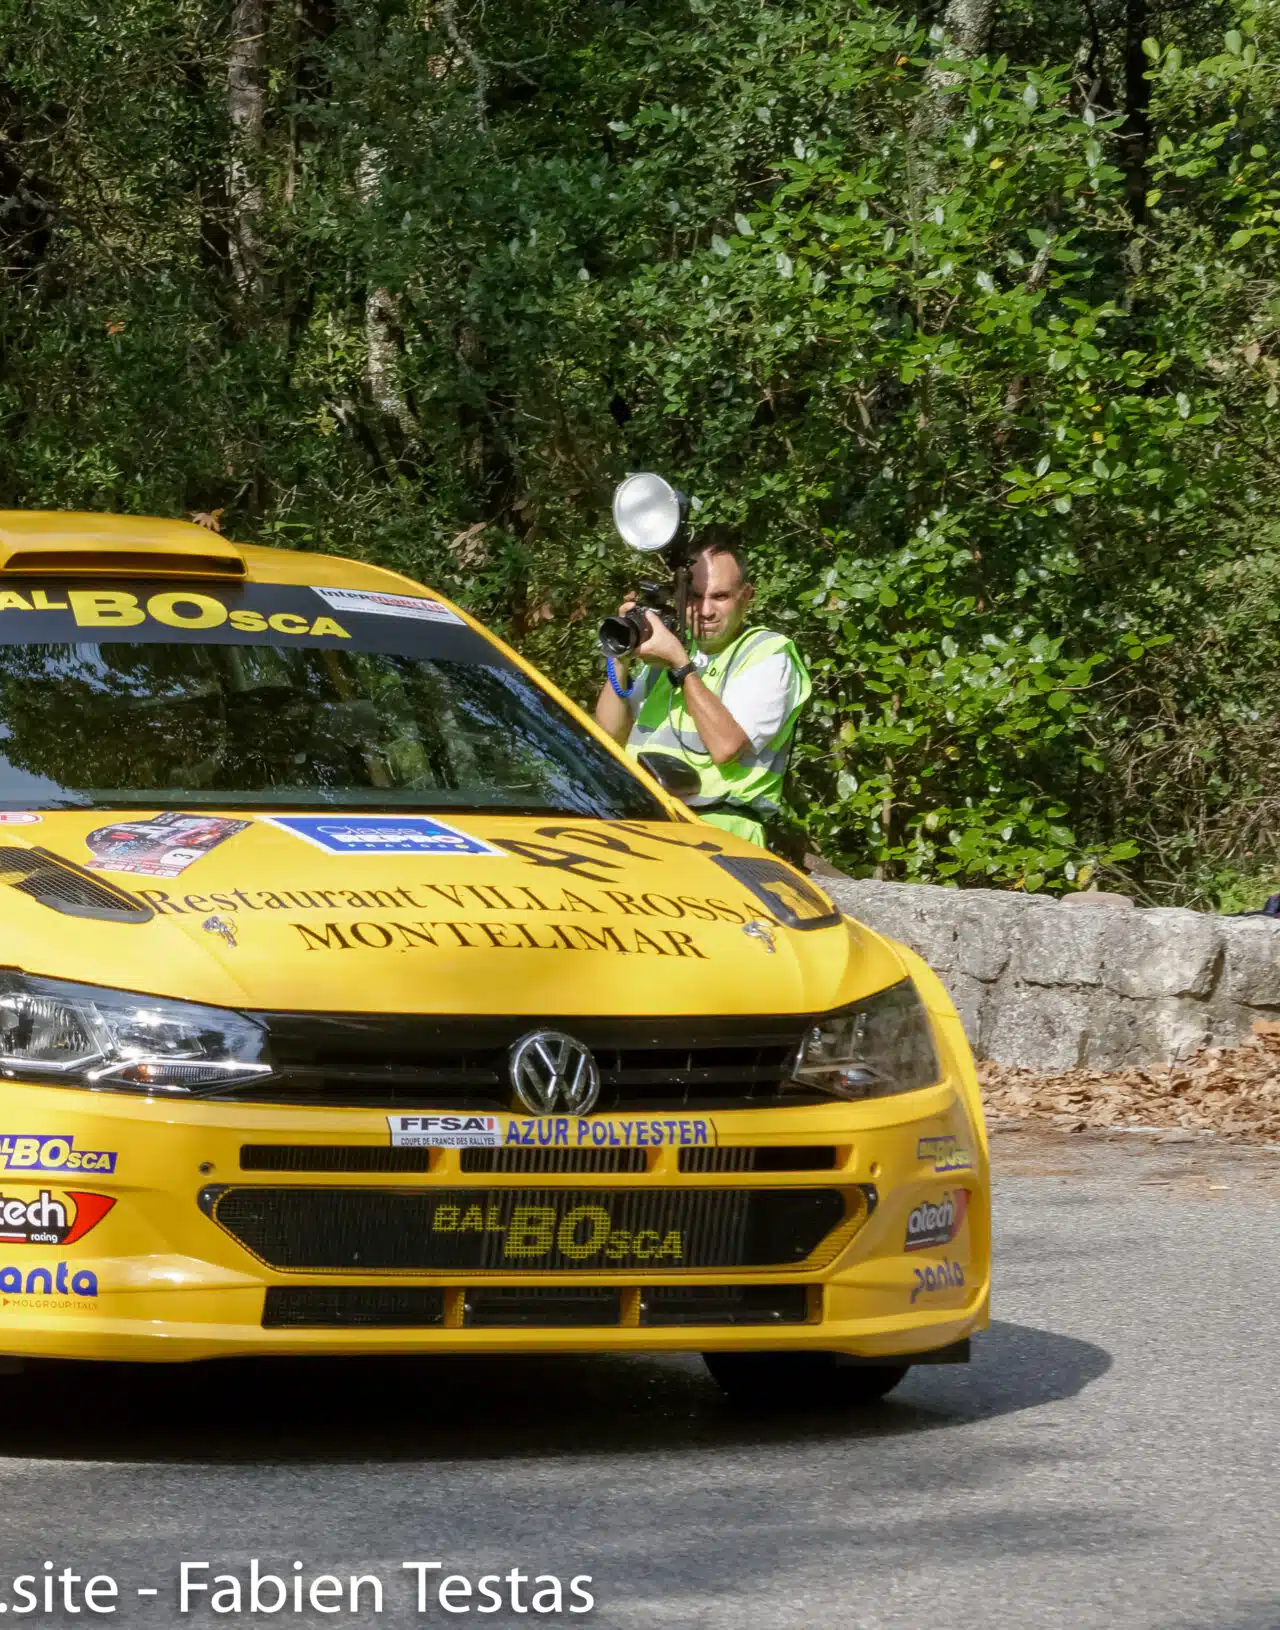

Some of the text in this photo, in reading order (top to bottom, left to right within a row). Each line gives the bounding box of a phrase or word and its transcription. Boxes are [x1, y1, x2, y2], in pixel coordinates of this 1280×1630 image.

[132, 883, 782, 928] Restaurant VILLA ROSSA
[288, 921, 711, 960] MONTELIMAR
[400, 1117, 485, 1131] FFSA
[505, 1118, 708, 1146] AZUR POLYESTER
[401, 1137, 496, 1145] COUPE DE FRANCE DES RALLYES
[30, 1232, 59, 1244] racing
[432, 1204, 683, 1259] BALBOSCA
